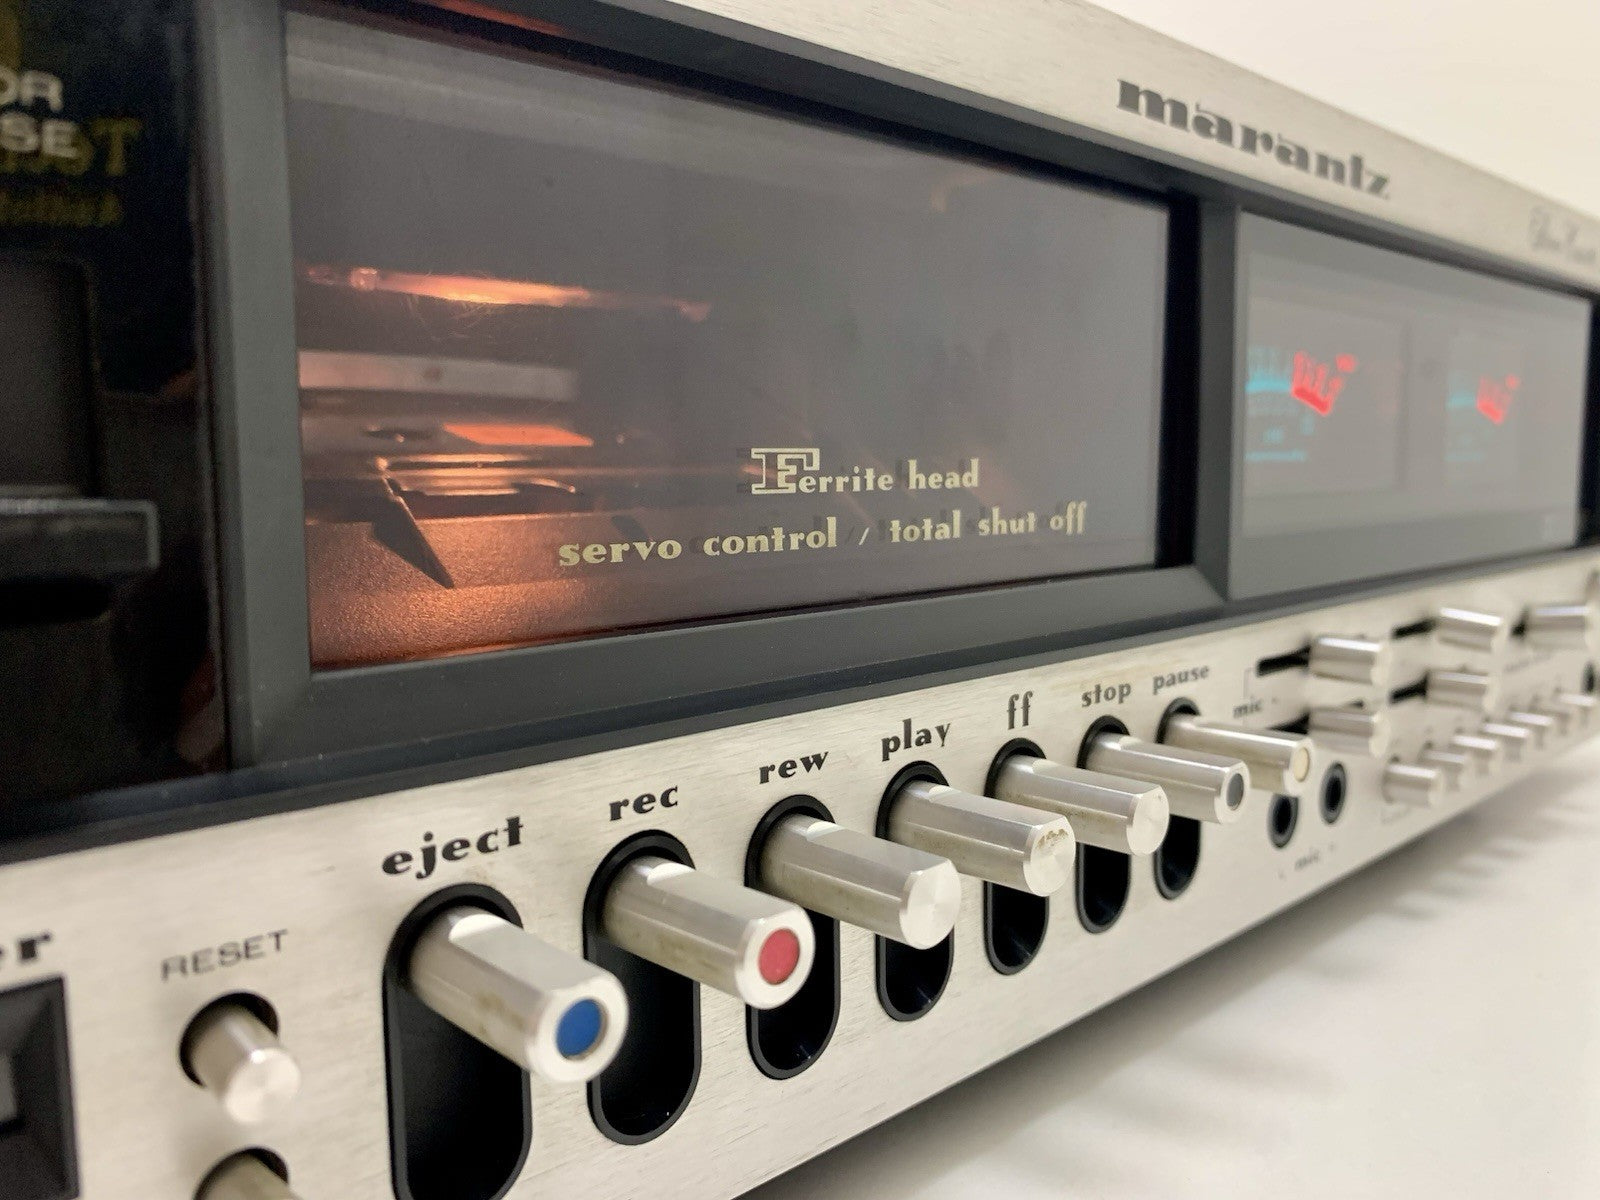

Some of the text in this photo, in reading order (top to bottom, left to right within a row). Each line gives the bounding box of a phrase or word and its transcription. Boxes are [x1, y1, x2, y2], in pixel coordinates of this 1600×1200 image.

[1117, 78, 1390, 198] marantz
[751, 448, 980, 494] Ferrite head
[559, 538, 682, 566] servo
[703, 517, 838, 557] control
[890, 510, 962, 543] total
[978, 505, 1036, 536] shut
[1050, 501, 1089, 535] off
[1081, 680, 1132, 709] stop
[1152, 663, 1211, 695] pause
[1006, 691, 1034, 729] ff
[881, 718, 952, 761] play
[758, 750, 829, 784] rew
[609, 785, 679, 821] rec
[381, 816, 524, 879] eject
[161, 929, 289, 981] RESET
